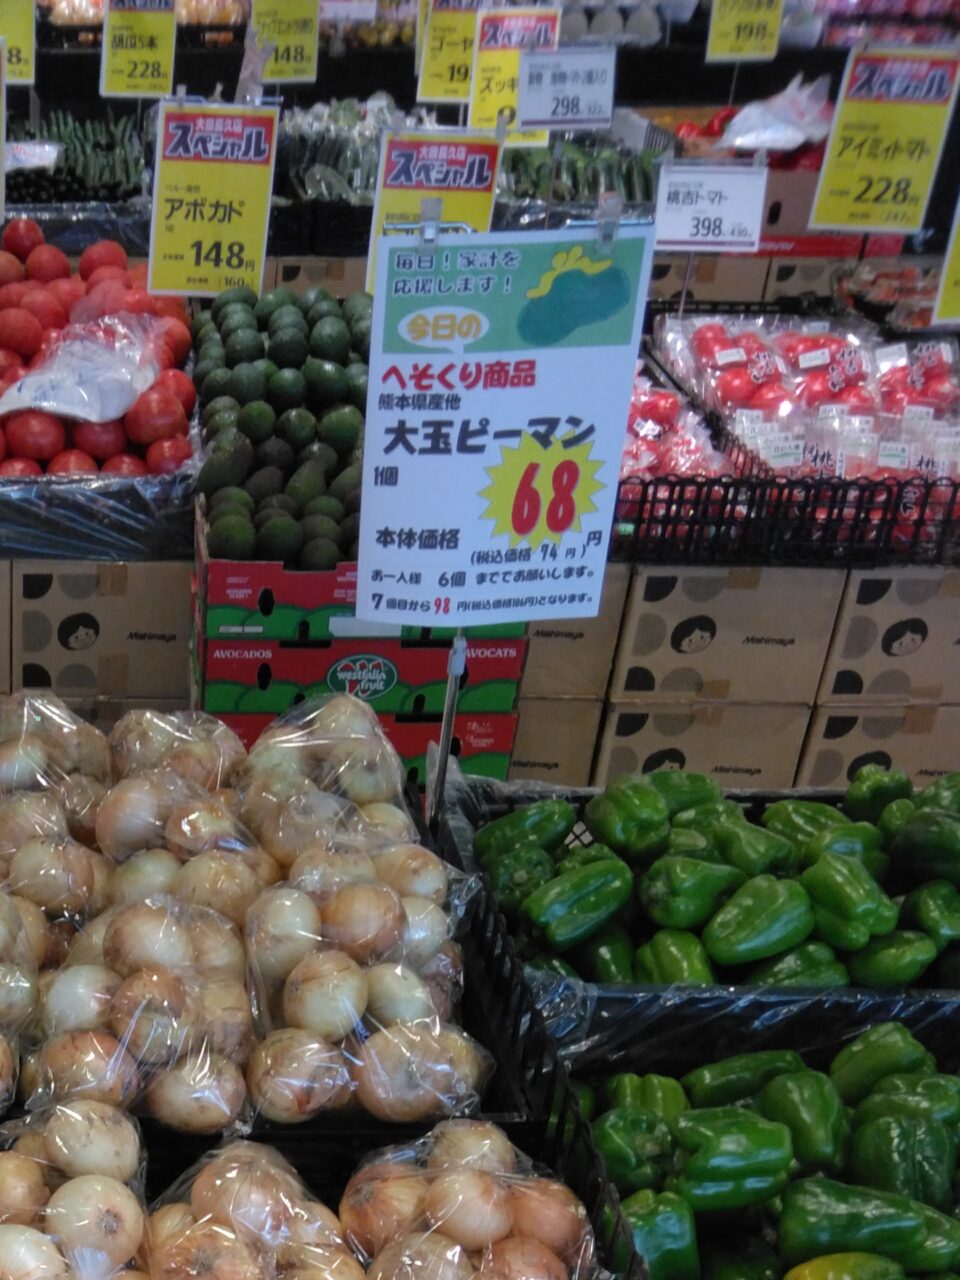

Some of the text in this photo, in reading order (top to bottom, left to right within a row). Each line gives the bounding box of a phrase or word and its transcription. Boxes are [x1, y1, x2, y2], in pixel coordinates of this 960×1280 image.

[448, 63, 471, 83] 19
[165, 120, 269, 161] スペシャル
[387, 150, 492, 188] スペシャル
[164, 197, 246, 224] アボカド
[406, 313, 482, 341] 今日の
[381, 360, 537, 391] へそくり商品
[377, 393, 462, 411] 熊本県産他
[383, 416, 597, 456] 大玉ピーマン
[511, 459, 580, 536] 68
[375, 527, 461, 551] 本体価格
[371, 569, 422, 585] お一人様
[126, 631, 177, 643] Mishimaya
[532, 629, 585, 640] Mishimaya
[742, 634, 796, 647] Mishimaya
[213, 649, 272, 659] AVOCADOS
